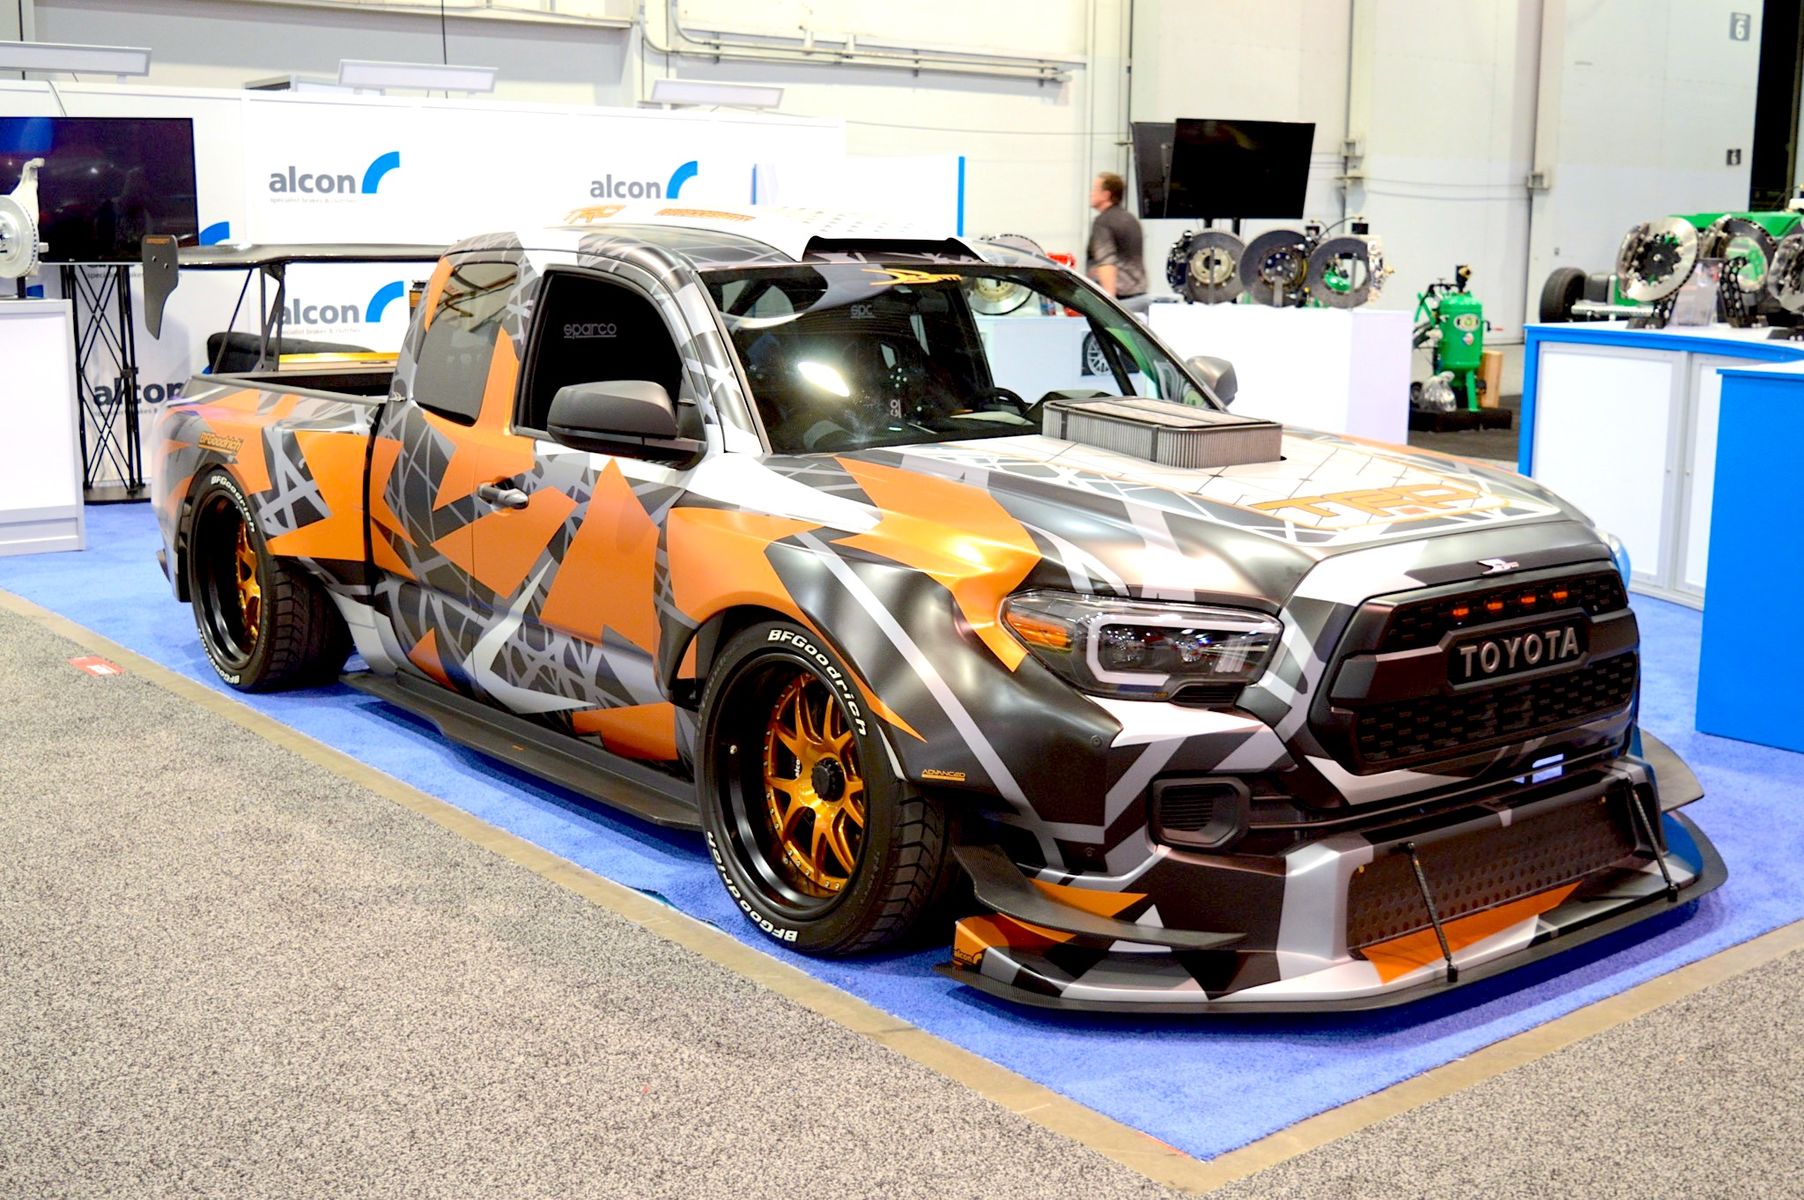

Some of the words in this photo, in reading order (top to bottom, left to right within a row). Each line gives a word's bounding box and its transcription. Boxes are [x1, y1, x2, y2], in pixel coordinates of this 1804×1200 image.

[1735, 20, 1745, 40] 6
[269, 166, 356, 193] alcon
[590, 174, 661, 199] alcon
[563, 323, 617, 338] sparco
[199, 432, 243, 451] BFGoodrich
[211, 475, 255, 532] BFGoodrich
[1459, 627, 1579, 677] TOYOTA
[767, 629, 867, 735] BFGoodrich
[707, 831, 798, 942] BFGoodrich
